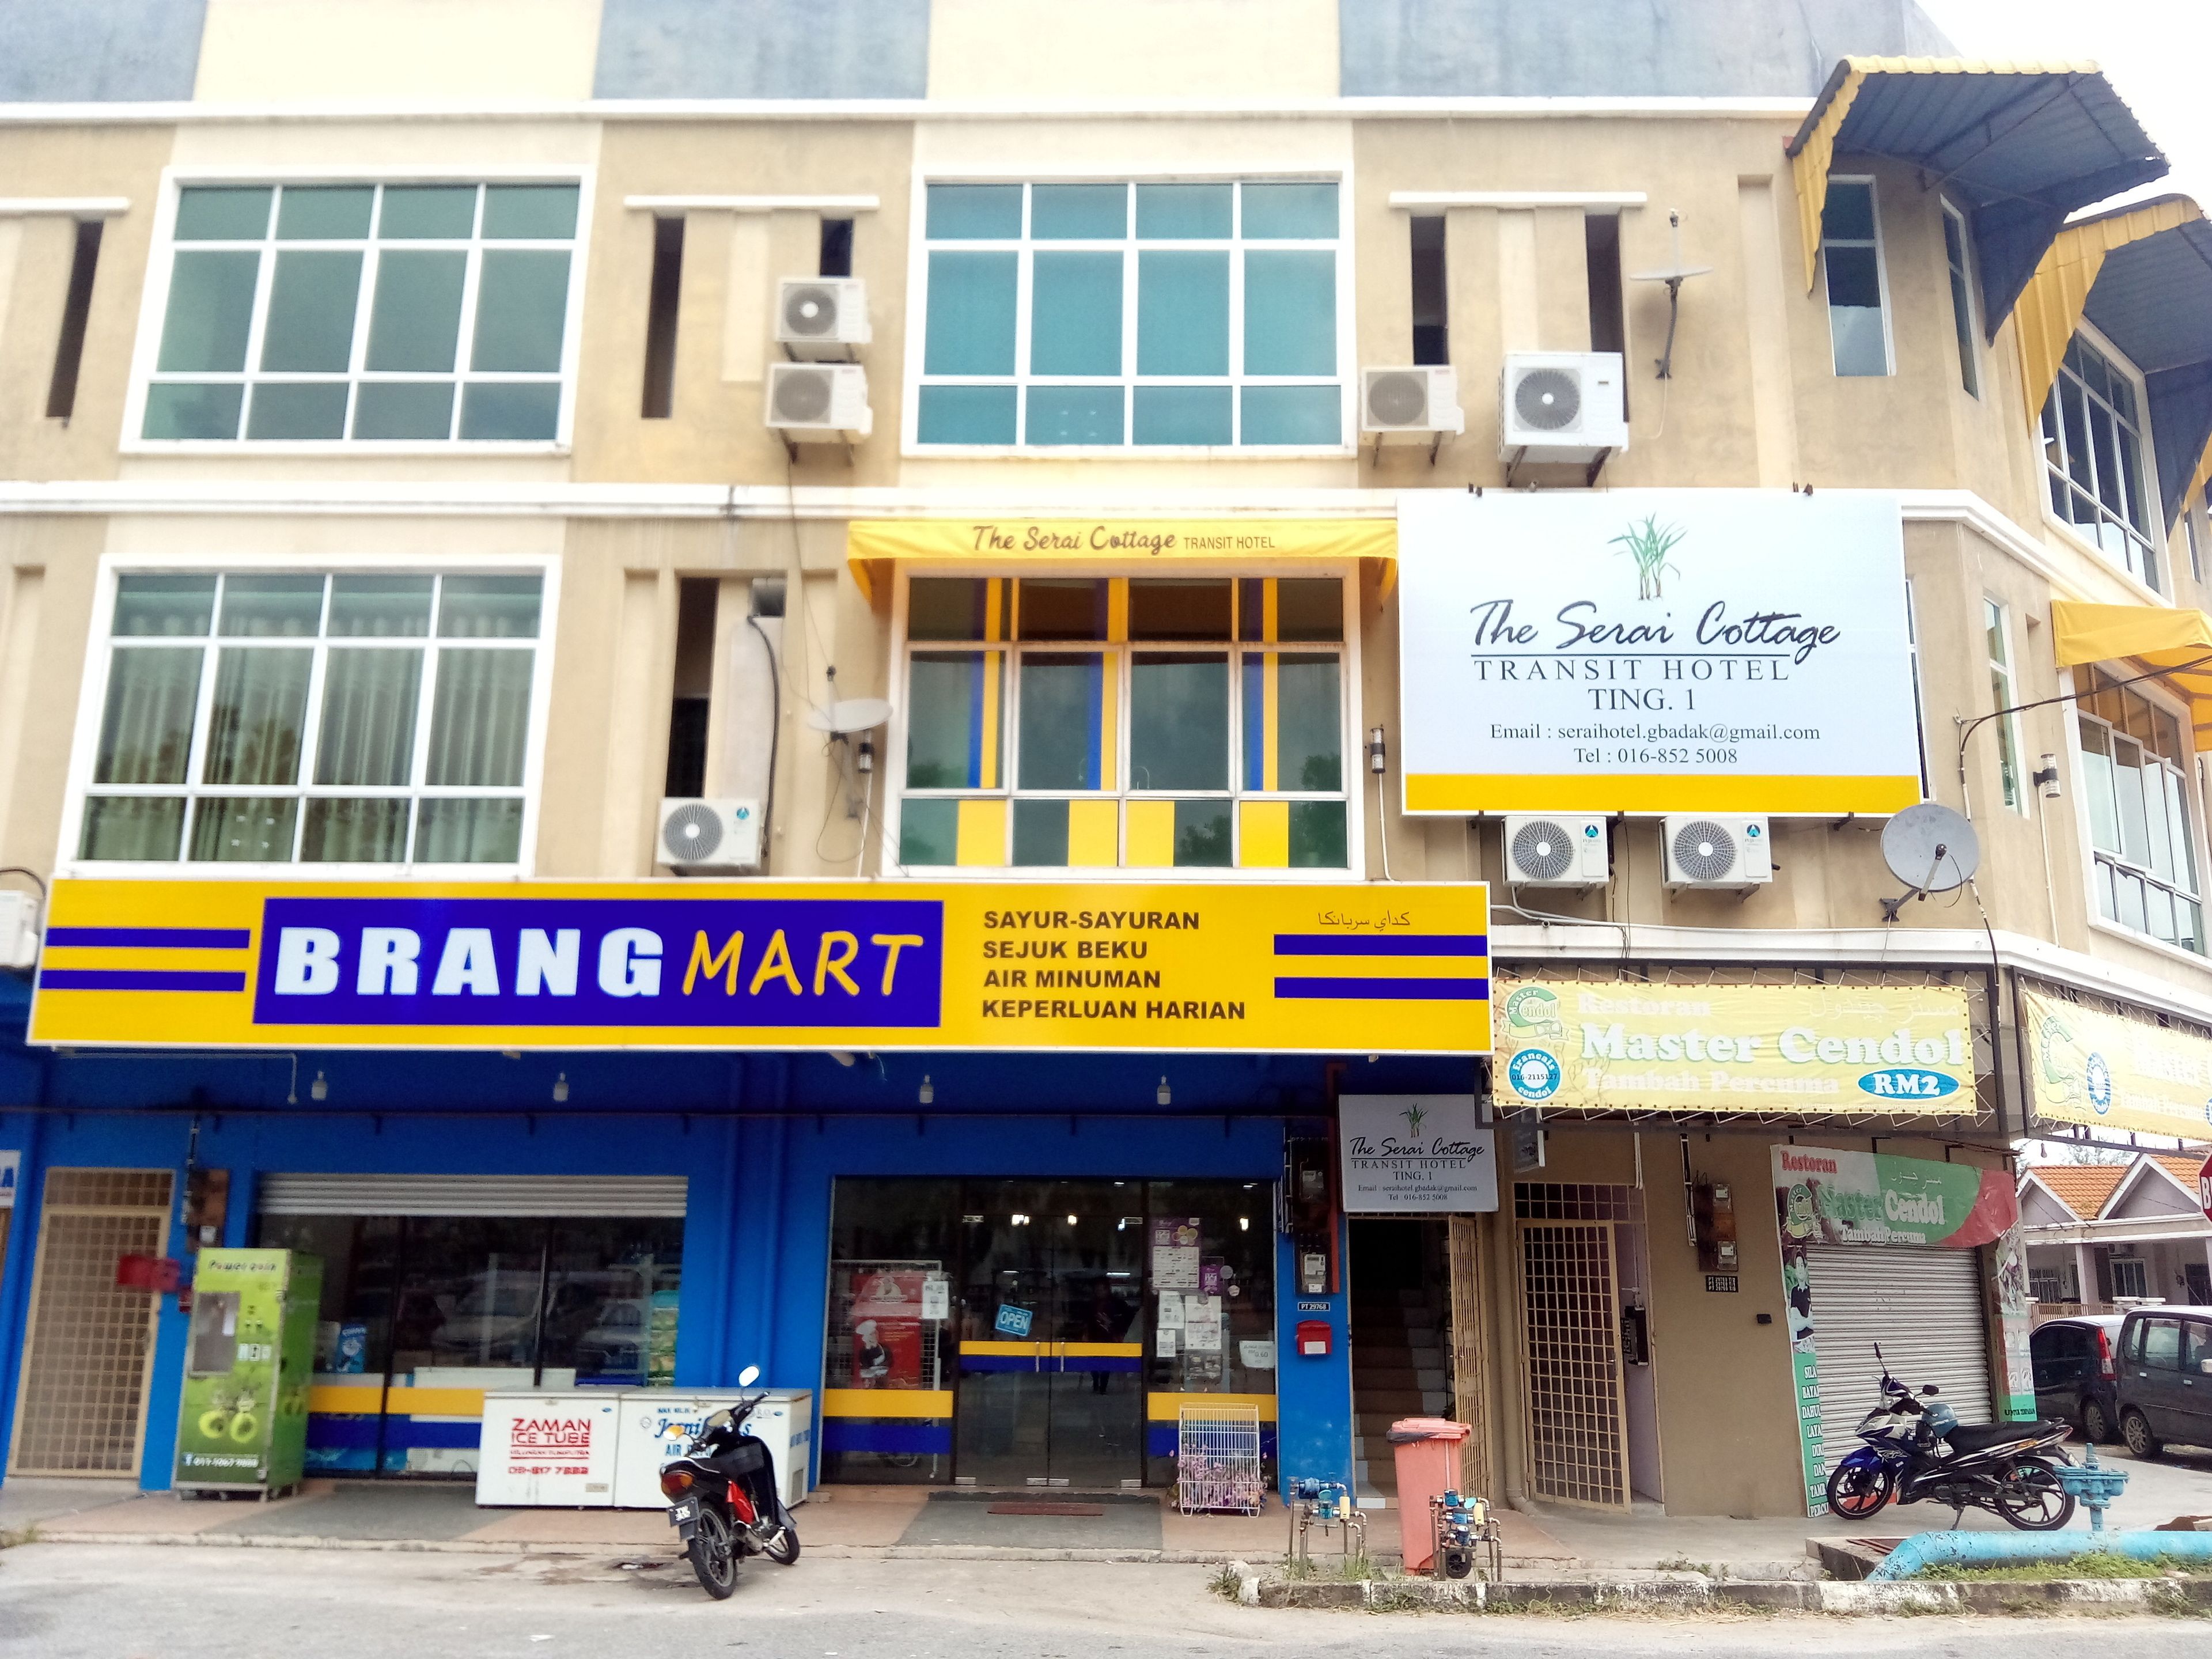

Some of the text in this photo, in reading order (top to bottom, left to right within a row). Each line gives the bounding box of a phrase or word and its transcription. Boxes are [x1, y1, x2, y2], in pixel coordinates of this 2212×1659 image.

[972, 525, 1275, 556] The Serai Cottage TRANSIT HOTEL
[1470, 600, 1840, 665] The Serai Cottage
[1474, 660, 1789, 681] TRANSIT HOTEL
[1588, 689, 1695, 710] TING. 1
[1490, 724, 1541, 740] Email
[1558, 724, 1820, 743] seraihotel.gbadak@gmail.com
[1574, 748, 1601, 764] Tel
[1618, 748, 1689, 764] 016-852
[1696, 748, 1737, 764] 5008
[984, 911, 1200, 930] SAYUR-SAYURAN
[983, 941, 1147, 959] SEJUK BEKU
[275, 927, 924, 997] BRANG MART
[983, 970, 1161, 988] AIR MINUMAN
[983, 1000, 1245, 1020] KEPERLUAN HARIAN
[1509, 990, 1539, 1014] Master
[1578, 992, 1712, 1017] Restoran
[1580, 1022, 1964, 1065] Master Cendol
[1583, 1067, 1839, 1094] Tambah Percuma
[1873, 1073, 1941, 1096] RM2
[1518, 1086, 1552, 1098] cendol
[1350, 1137, 1484, 1162] The Serai Cottage
[1351, 1160, 1466, 1169] TRANSIT HOTEL
[1780, 1151, 1838, 1174] Restoran
[1393, 1171, 1433, 1180] TING. 1
[1817, 1184, 1946, 1225] Master Cendol
[1841, 1224, 1926, 1244] Tambah Percuma
[1000, 1311, 1028, 1329] OPEN
[1804, 1365, 1817, 1379] SILA
[1801, 1404, 1821, 1419] DAHUL
[512, 1418, 591, 1431] ZAMAN
[1806, 1424, 1823, 1438] LAYA
[512, 1433, 590, 1443] ICE TUBE
[665, 1444, 682, 1457] AIR
